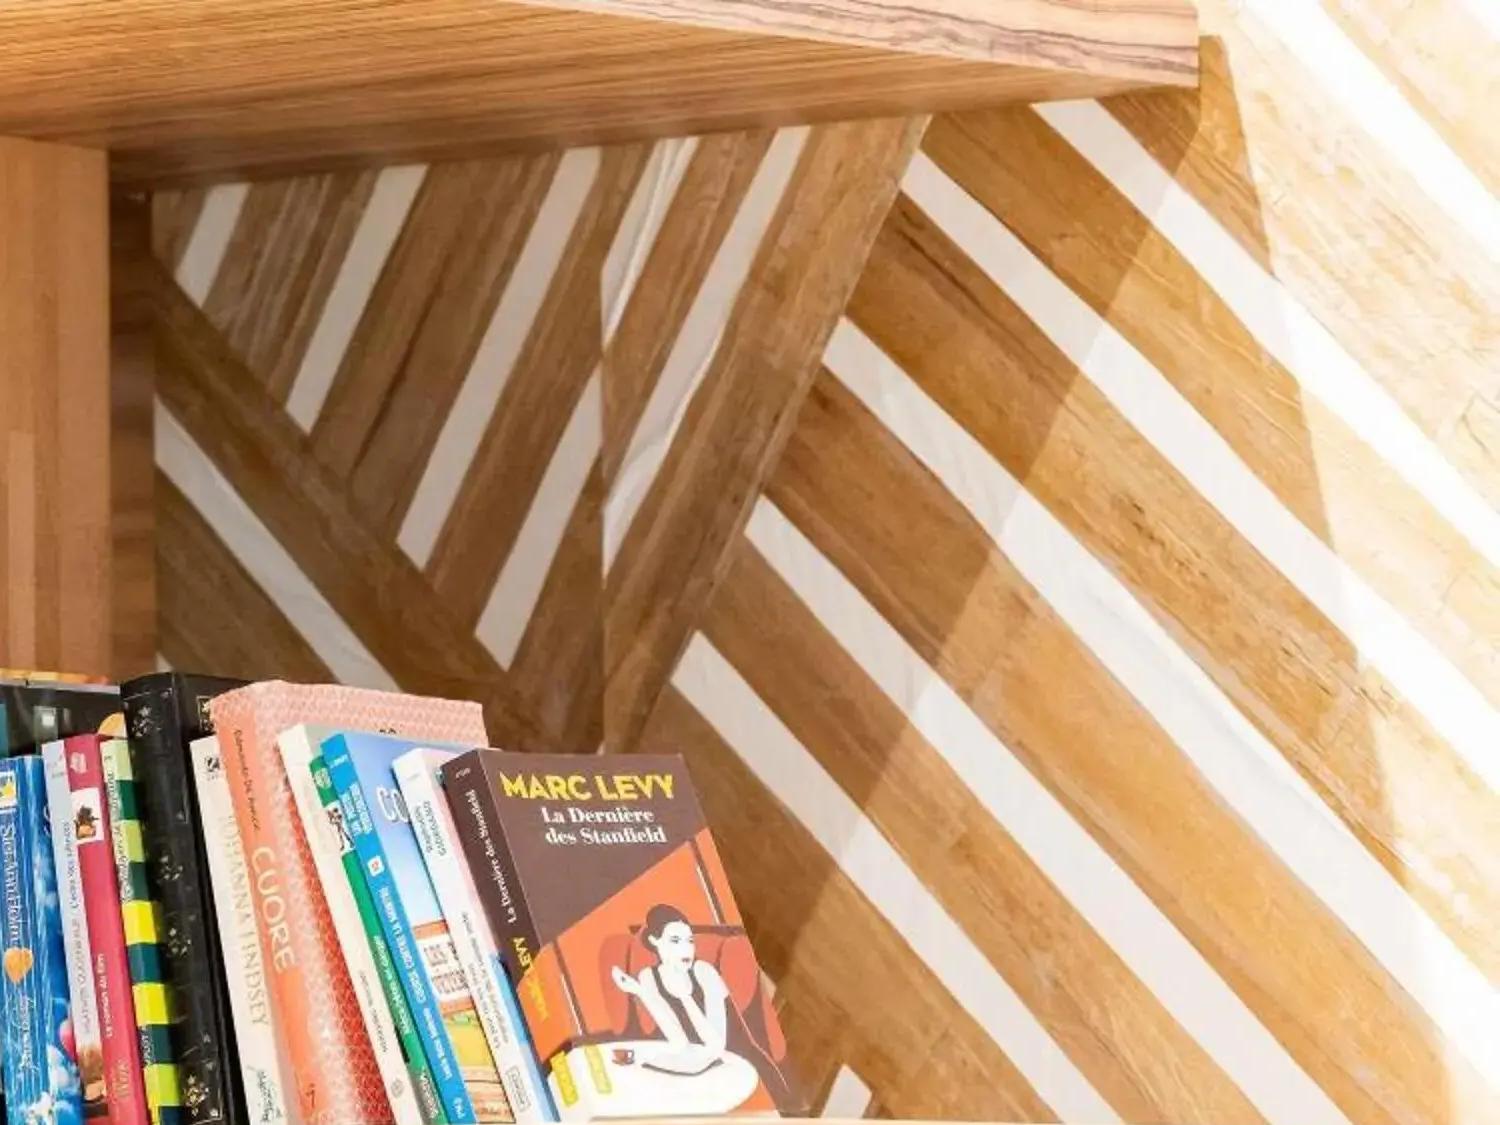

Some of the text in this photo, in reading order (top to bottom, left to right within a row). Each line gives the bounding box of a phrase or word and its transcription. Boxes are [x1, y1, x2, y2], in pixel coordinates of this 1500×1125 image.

[500, 772, 674, 800] MARC LEVY
[541, 806, 654, 823] La Dernière
[479, 835, 497, 858] des
[545, 827, 668, 844] des Stanfield
[486, 856, 513, 906] Dernière
[219, 814, 270, 1028] JOHANNA LINDSEY
[242, 843, 305, 974] CUORE
[502, 905, 518, 924] La
[509, 933, 538, 976] LEVY
